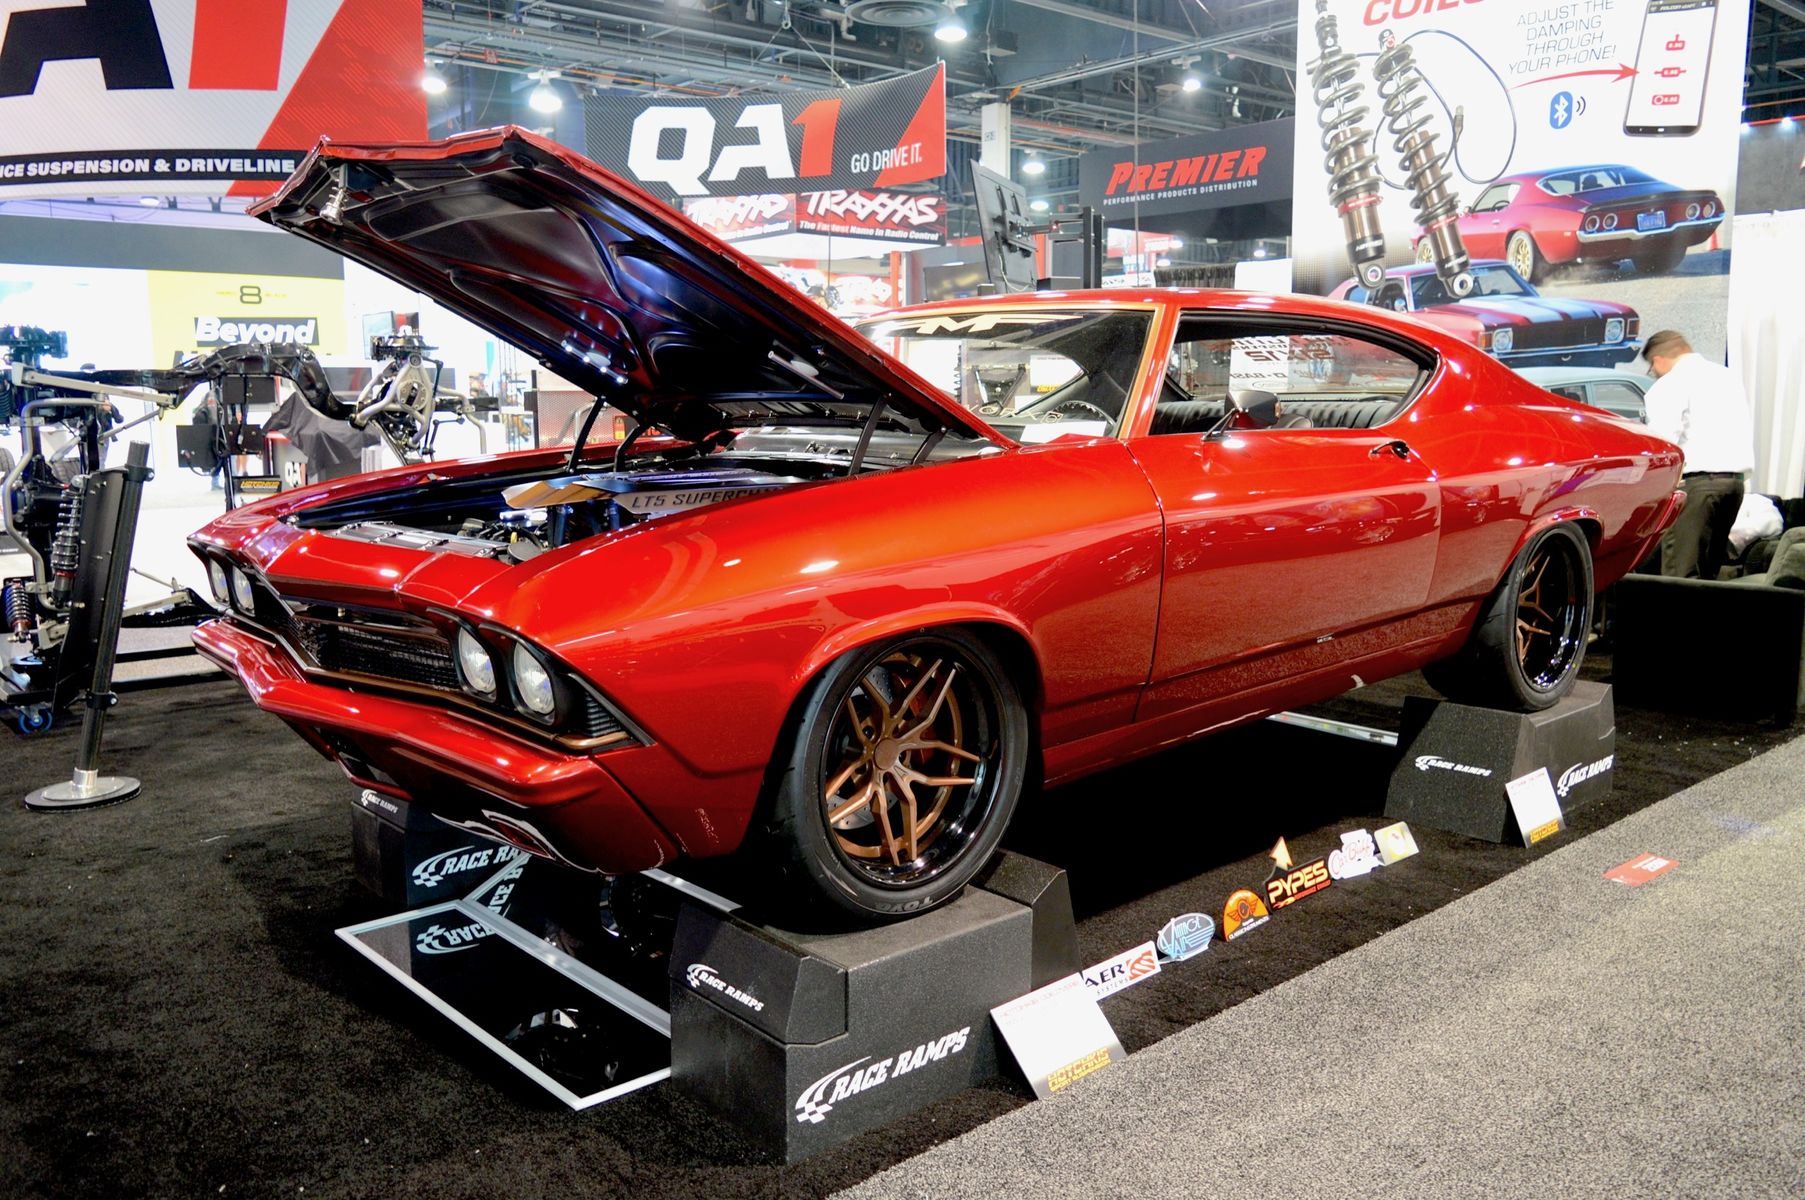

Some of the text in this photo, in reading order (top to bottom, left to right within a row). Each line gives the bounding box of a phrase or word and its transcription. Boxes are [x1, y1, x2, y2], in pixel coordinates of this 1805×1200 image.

[1517, 3, 1579, 26] ADJUST
[1526, 14, 1602, 41] DAMPING
[1526, 31, 1604, 56] THROUGH
[1508, 45, 1617, 75] YOUR PHONE!
[628, 98, 843, 195] QA1
[851, 143, 923, 173] GO DRIVE IT.
[0, 158, 296, 178] CE SUSPENSION & DRIVELINE
[1104, 146, 1267, 195] PREMIER
[1103, 179, 1258, 206] PERFORMANCE PRODUCTS DISTRIBUTION
[801, 189, 938, 226] TRAXXAS
[800, 220, 816, 230] The
[850, 226, 874, 236] Name
[885, 230, 908, 239] Radio
[909, 231, 939, 241] Control
[239, 285, 262, 305] 8
[196, 316, 316, 345] Beyond
[440, 849, 493, 876] RACE
[1268, 860, 1328, 904] PYPES
[699, 971, 764, 1011] RACE RAMPS
[828, 1027, 971, 1104] RACE RAMPS
